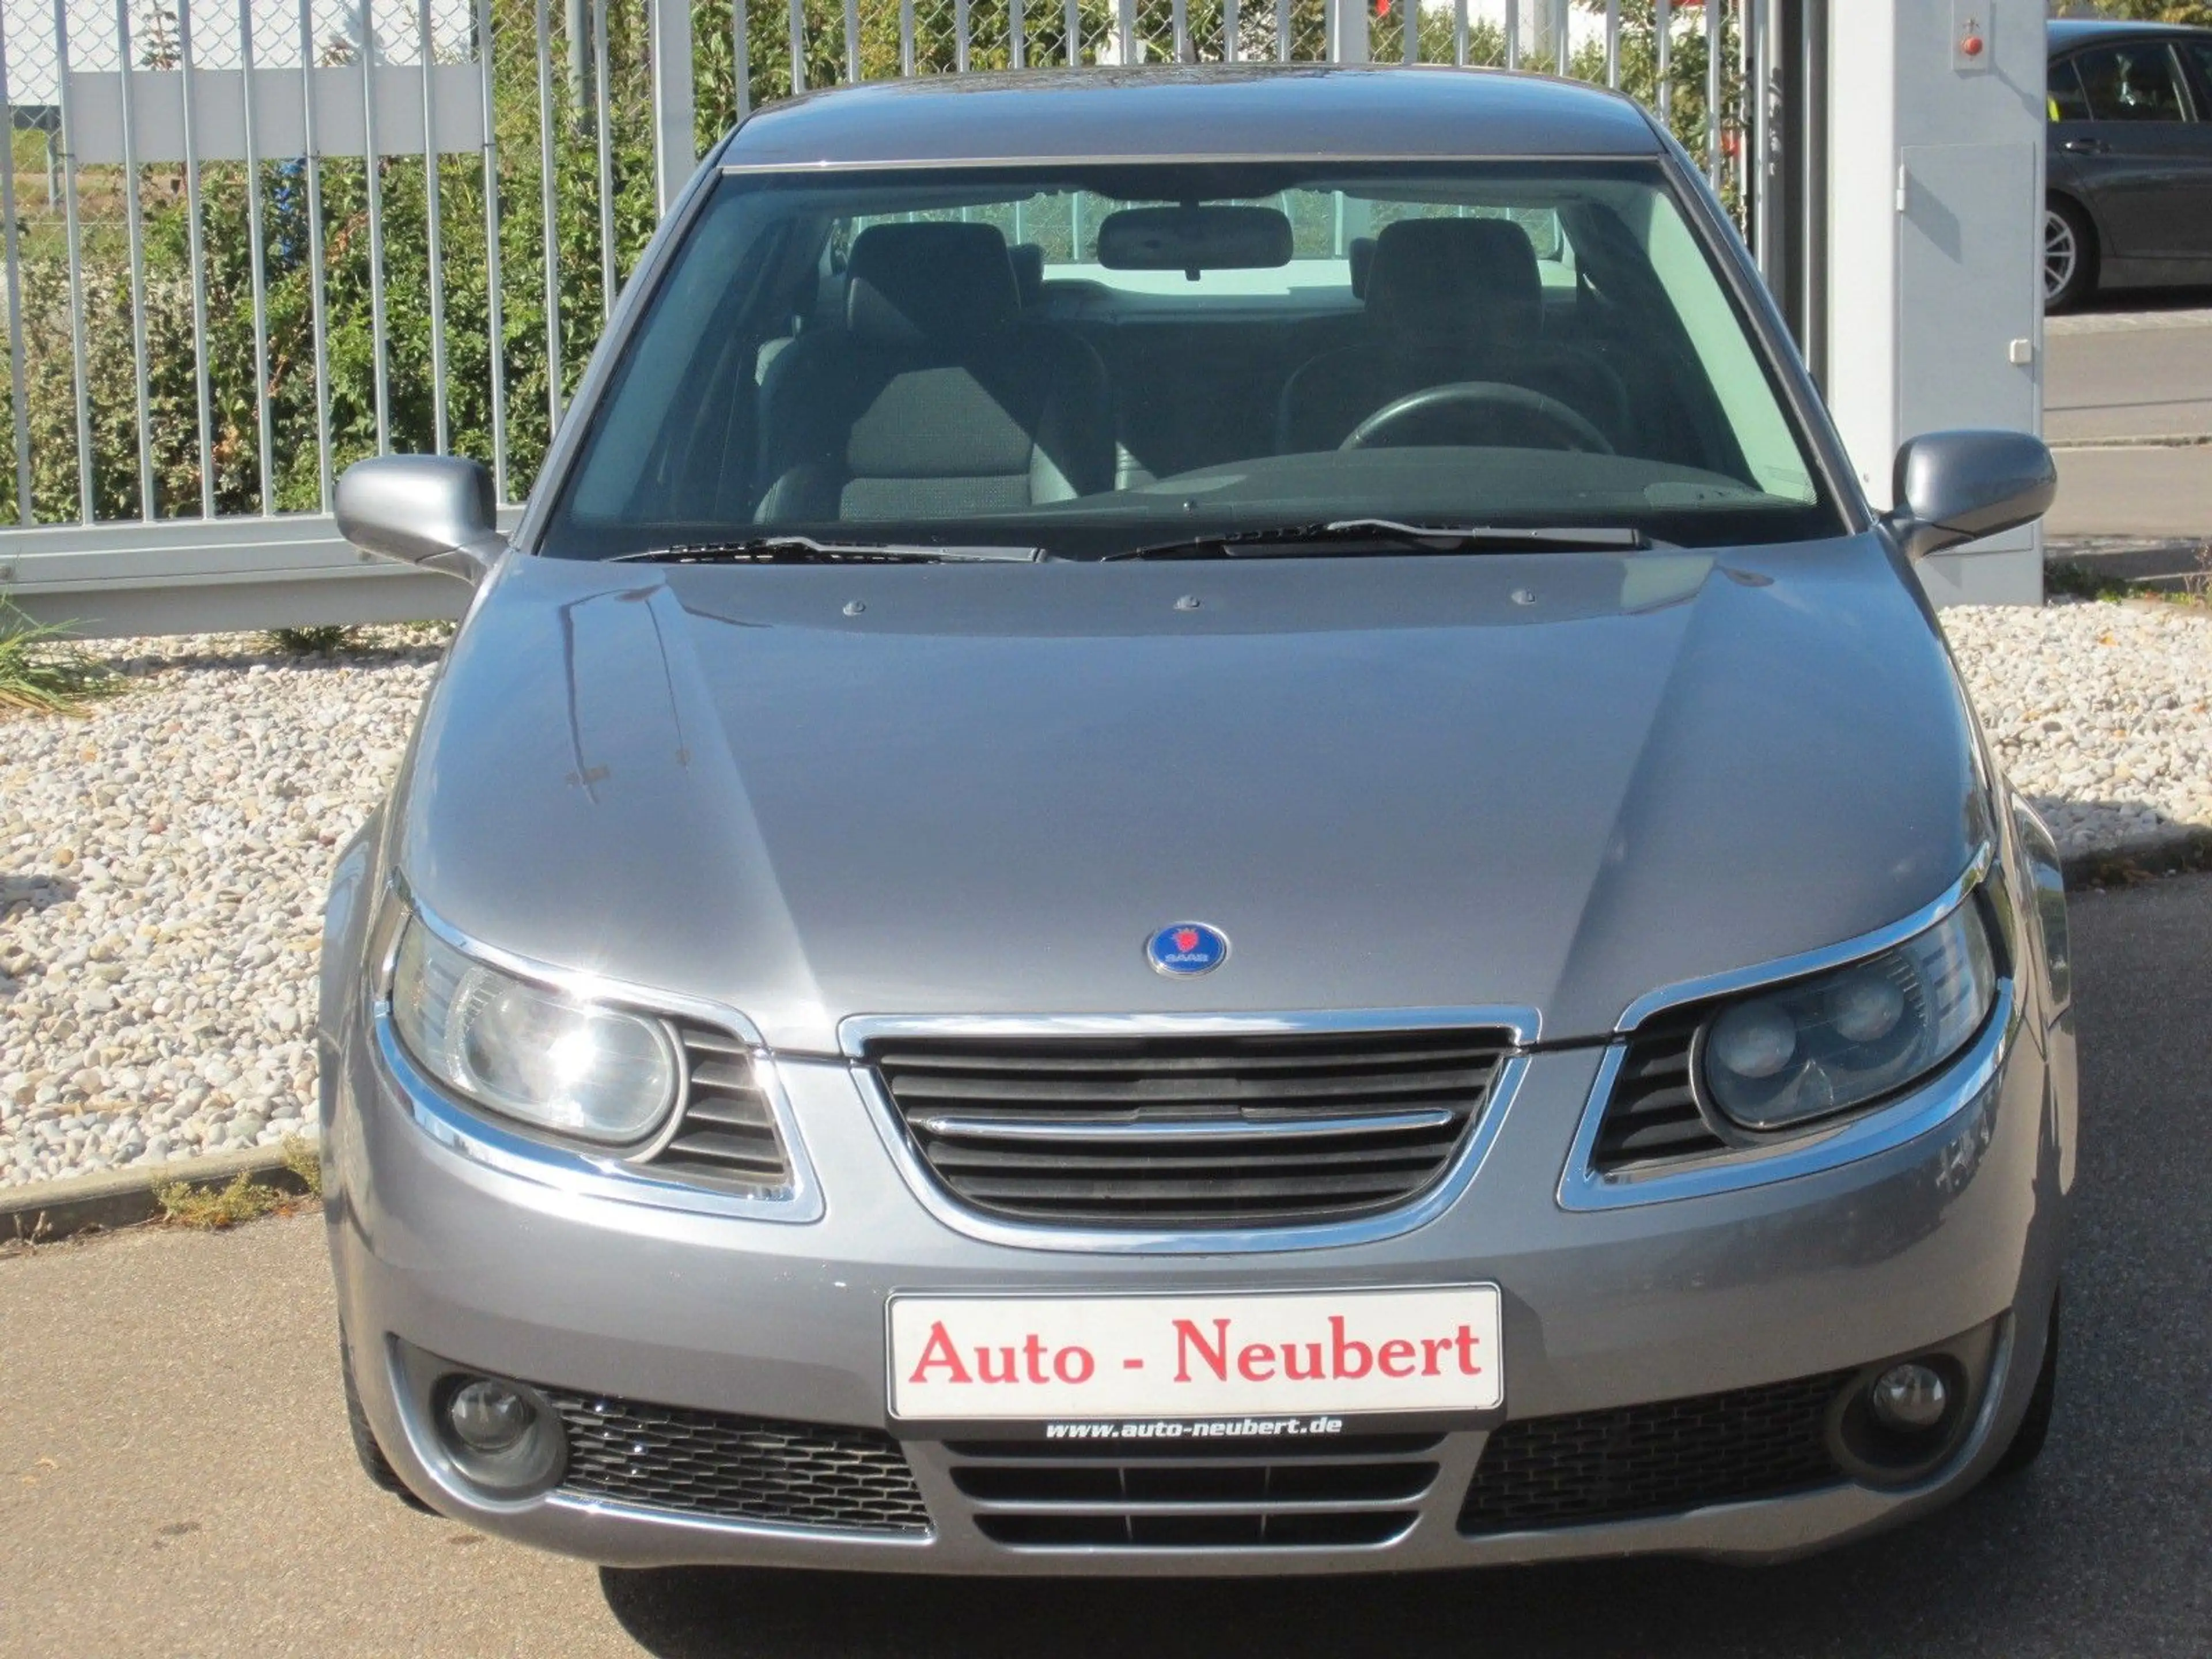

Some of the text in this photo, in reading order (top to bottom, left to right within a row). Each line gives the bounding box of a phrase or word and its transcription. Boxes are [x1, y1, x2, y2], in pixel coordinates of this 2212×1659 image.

[1165, 953, 1209, 962] SAAB
[910, 1316, 1481, 1384] Auto - Neubert
[1046, 1417, 1342, 1438] www.auto-neubert.de
